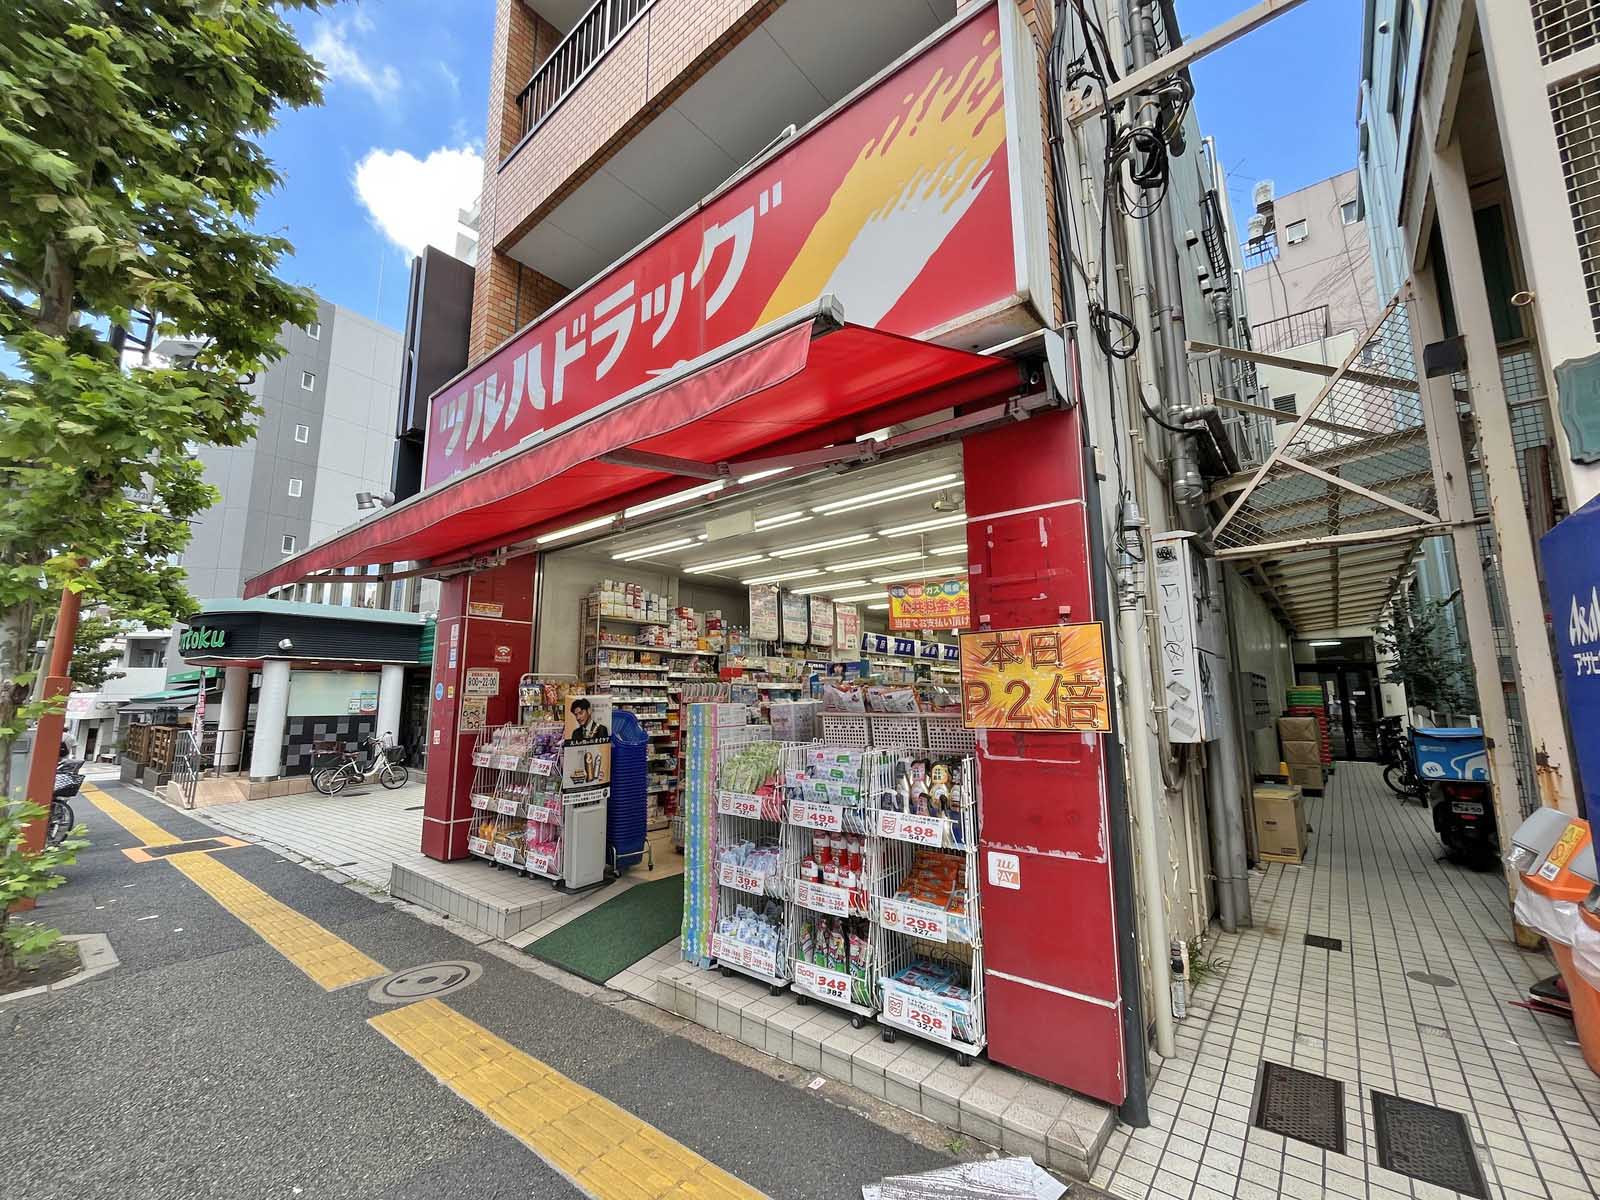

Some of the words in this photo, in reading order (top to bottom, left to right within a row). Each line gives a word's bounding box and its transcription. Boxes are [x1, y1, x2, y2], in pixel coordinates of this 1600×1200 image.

[440, 181, 784, 457] ツルハドラッグ
[926, 586, 941, 594] ガス
[980, 632, 1064, 672] 本日
